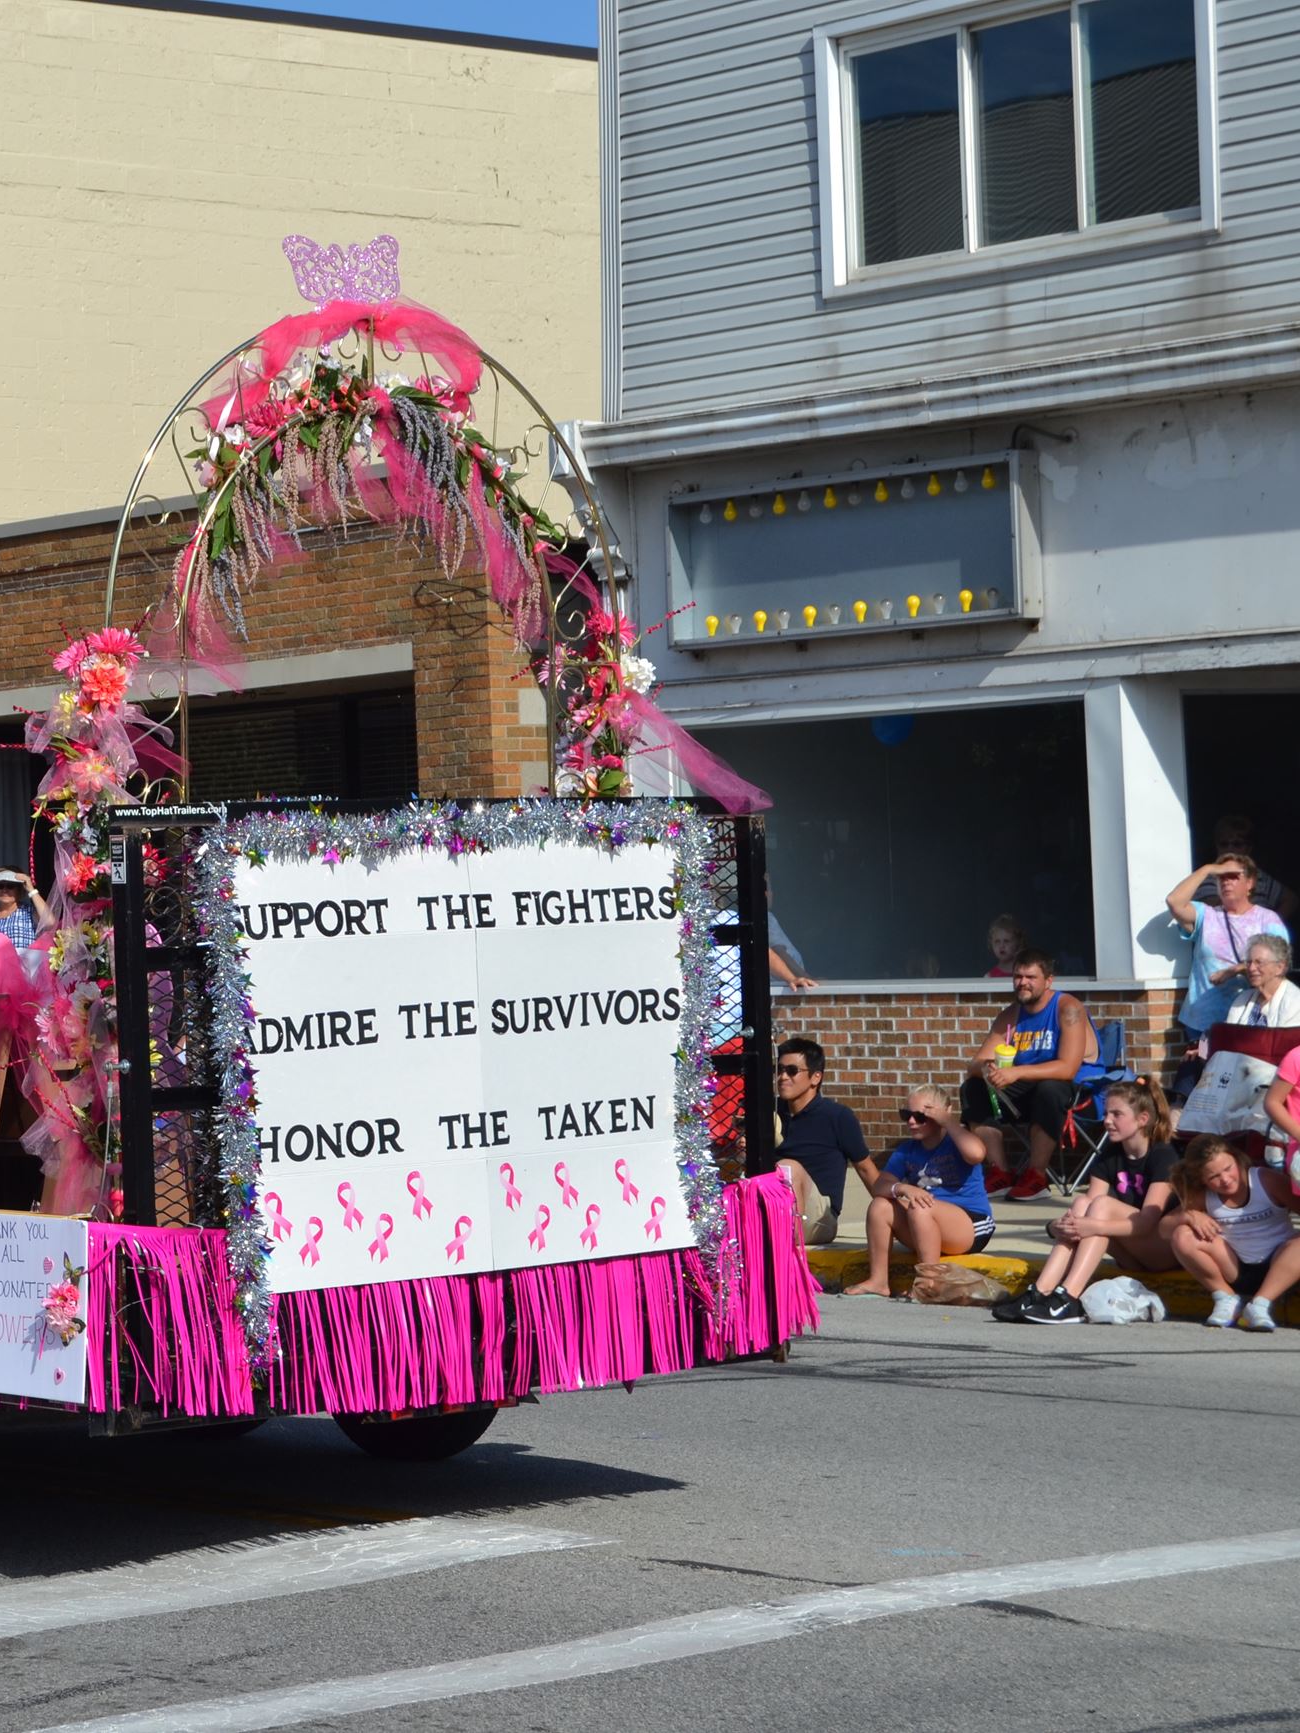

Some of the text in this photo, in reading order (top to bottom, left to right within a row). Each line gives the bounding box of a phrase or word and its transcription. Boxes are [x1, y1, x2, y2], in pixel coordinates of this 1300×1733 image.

[115, 805, 228, 817] www.TopHatTrailers.com
[417, 893, 497, 931] THE
[511, 886, 678, 926] FIGHTERS
[397, 999, 478, 1040] THE
[490, 988, 682, 1036] SURVIVORS
[253, 1094, 657, 1164] HONOR THE TAKEN
[25, 1221, 50, 1241] YOU
[1, 1243, 26, 1263] ALL
